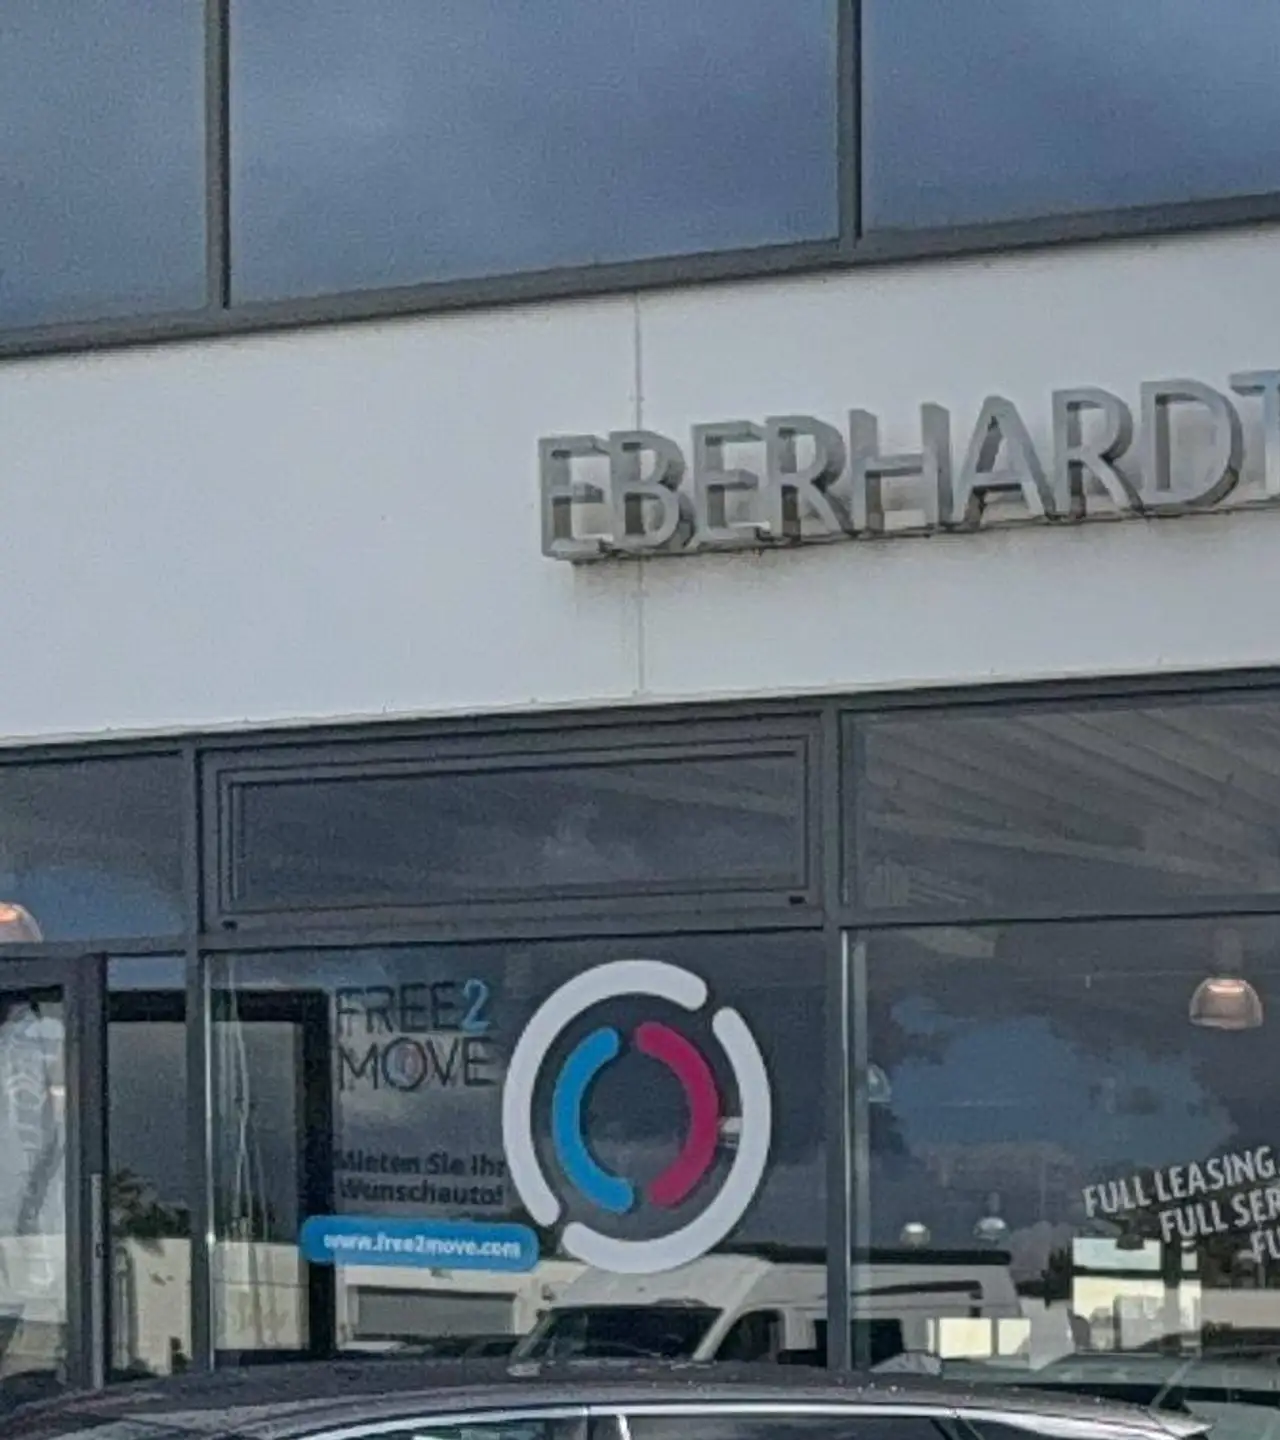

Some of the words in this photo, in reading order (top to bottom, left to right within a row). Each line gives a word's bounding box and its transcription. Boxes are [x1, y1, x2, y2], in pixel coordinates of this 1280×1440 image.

[334, 978, 491, 1034] FREE2
[337, 1036, 500, 1092] MOVE
[424, 1152, 467, 1175] Sie
[1082, 1176, 1152, 1218] FULL
[1158, 1205, 1231, 1244] FULL
[322, 1230, 522, 1260] www.free2move.com
